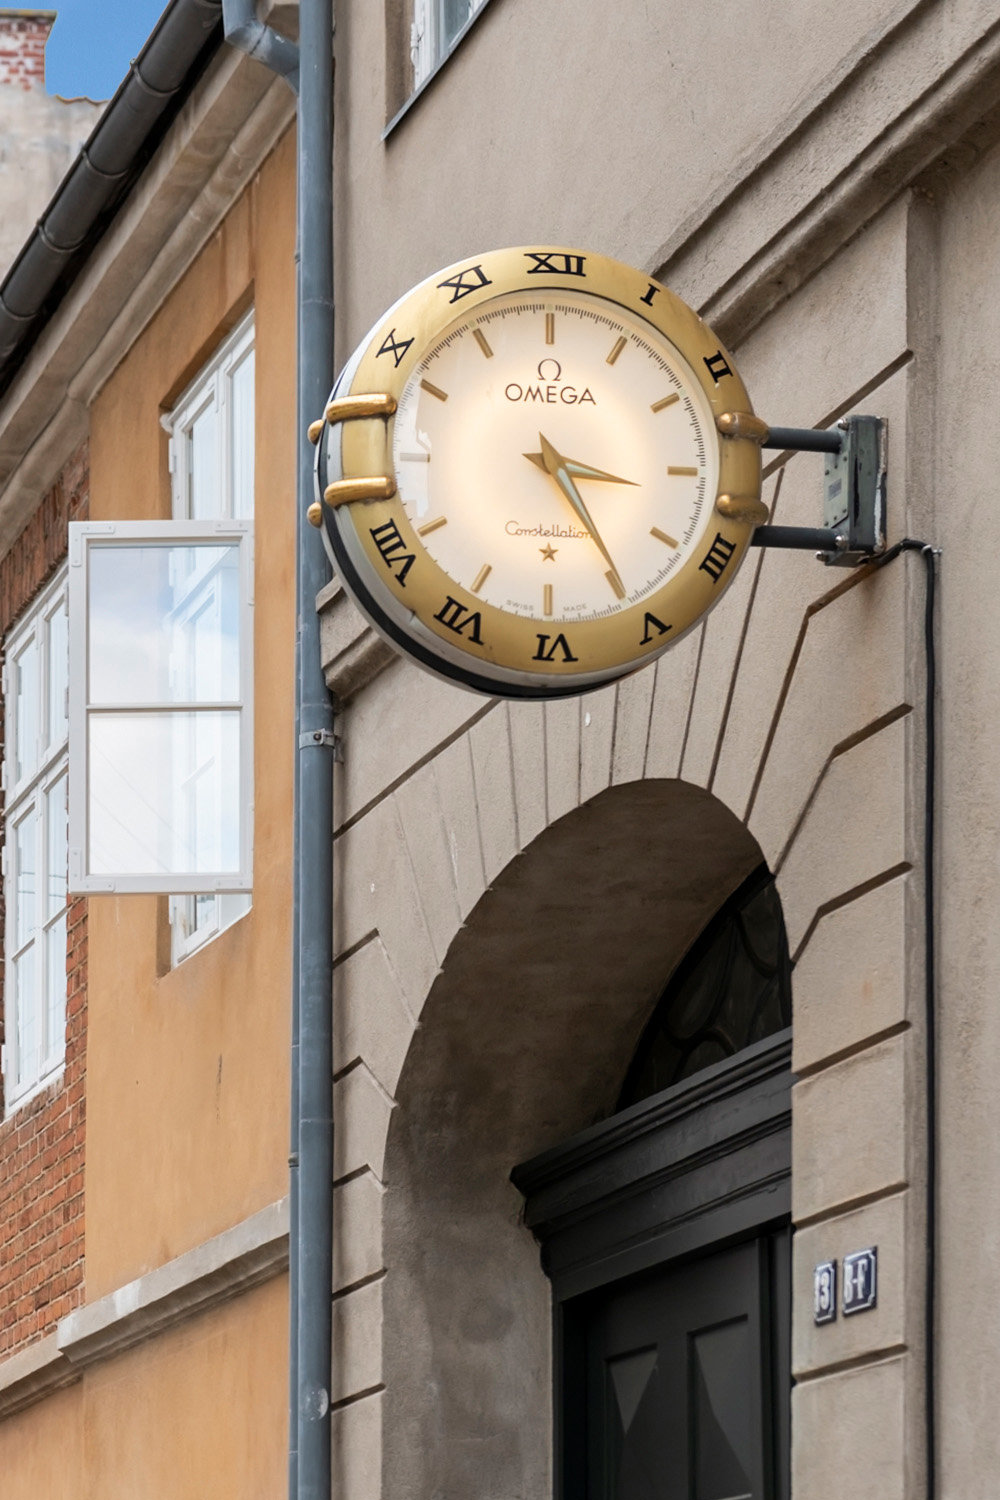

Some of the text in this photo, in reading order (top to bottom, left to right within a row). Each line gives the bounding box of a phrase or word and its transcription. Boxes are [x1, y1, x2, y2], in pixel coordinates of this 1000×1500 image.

[525, 253, 586, 277] XII
[437, 265, 492, 304] XI
[640, 280, 663, 306] I
[377, 330, 414, 367] X
[703, 350, 734, 383] II
[505, 383, 596, 405] OMEGA
[504, 520, 593, 539] Constellation
[369, 518, 416, 588] VIII
[699, 533, 737, 584] III
[433, 596, 486, 646] VII
[506, 599, 587, 612] SWISS MADE
[639, 612, 672, 645] V
[532, 634, 578, 662] VI
